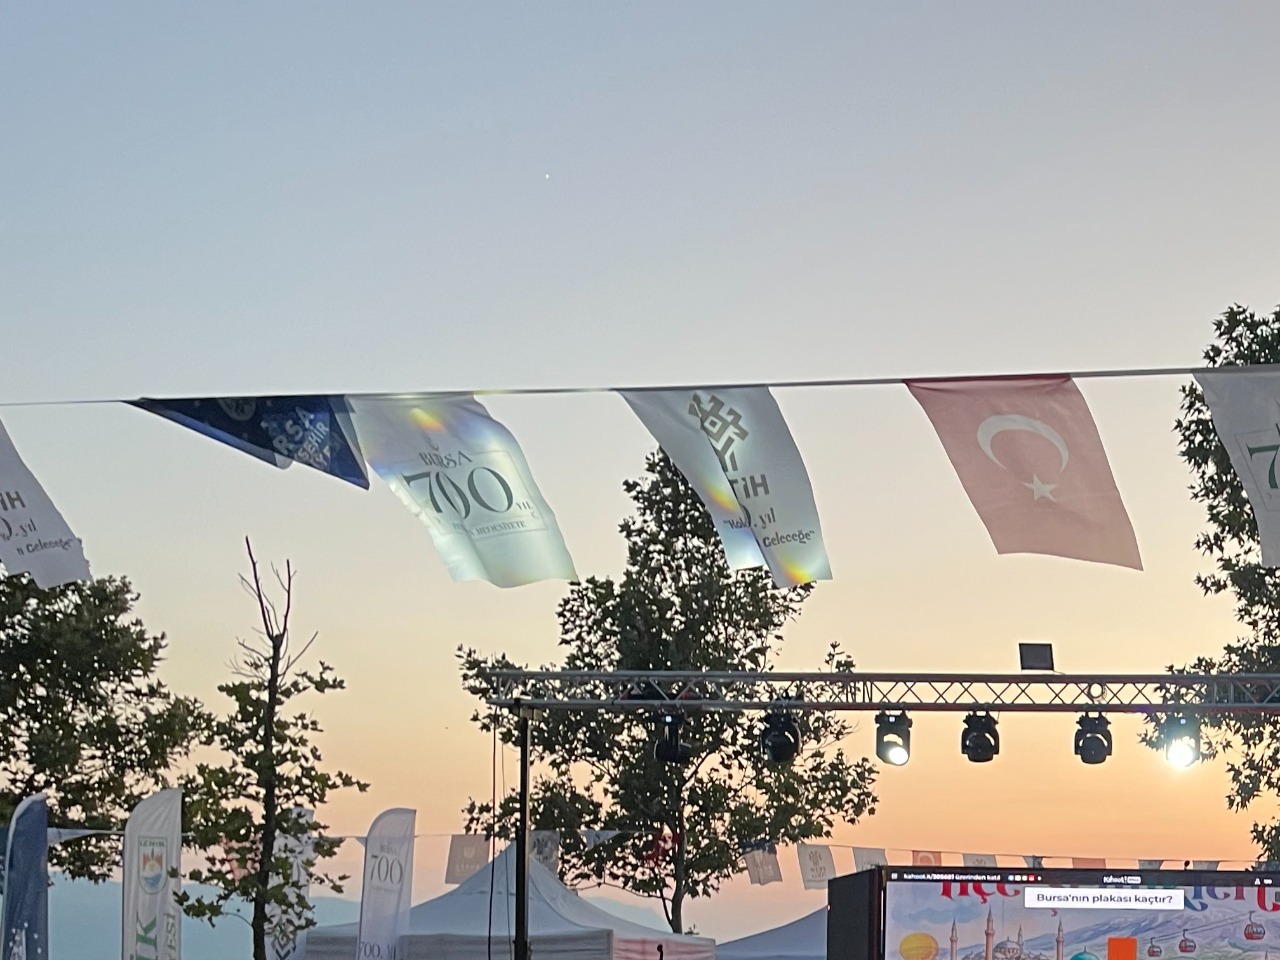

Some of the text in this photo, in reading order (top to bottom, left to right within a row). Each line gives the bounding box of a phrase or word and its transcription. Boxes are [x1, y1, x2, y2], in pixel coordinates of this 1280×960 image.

[402, 466, 514, 519] 700
[759, 507, 776, 530] yıl
[370, 854, 404, 885] 700
[1036, 893, 1173, 906] Bursa'nın plakası kaçtır?
